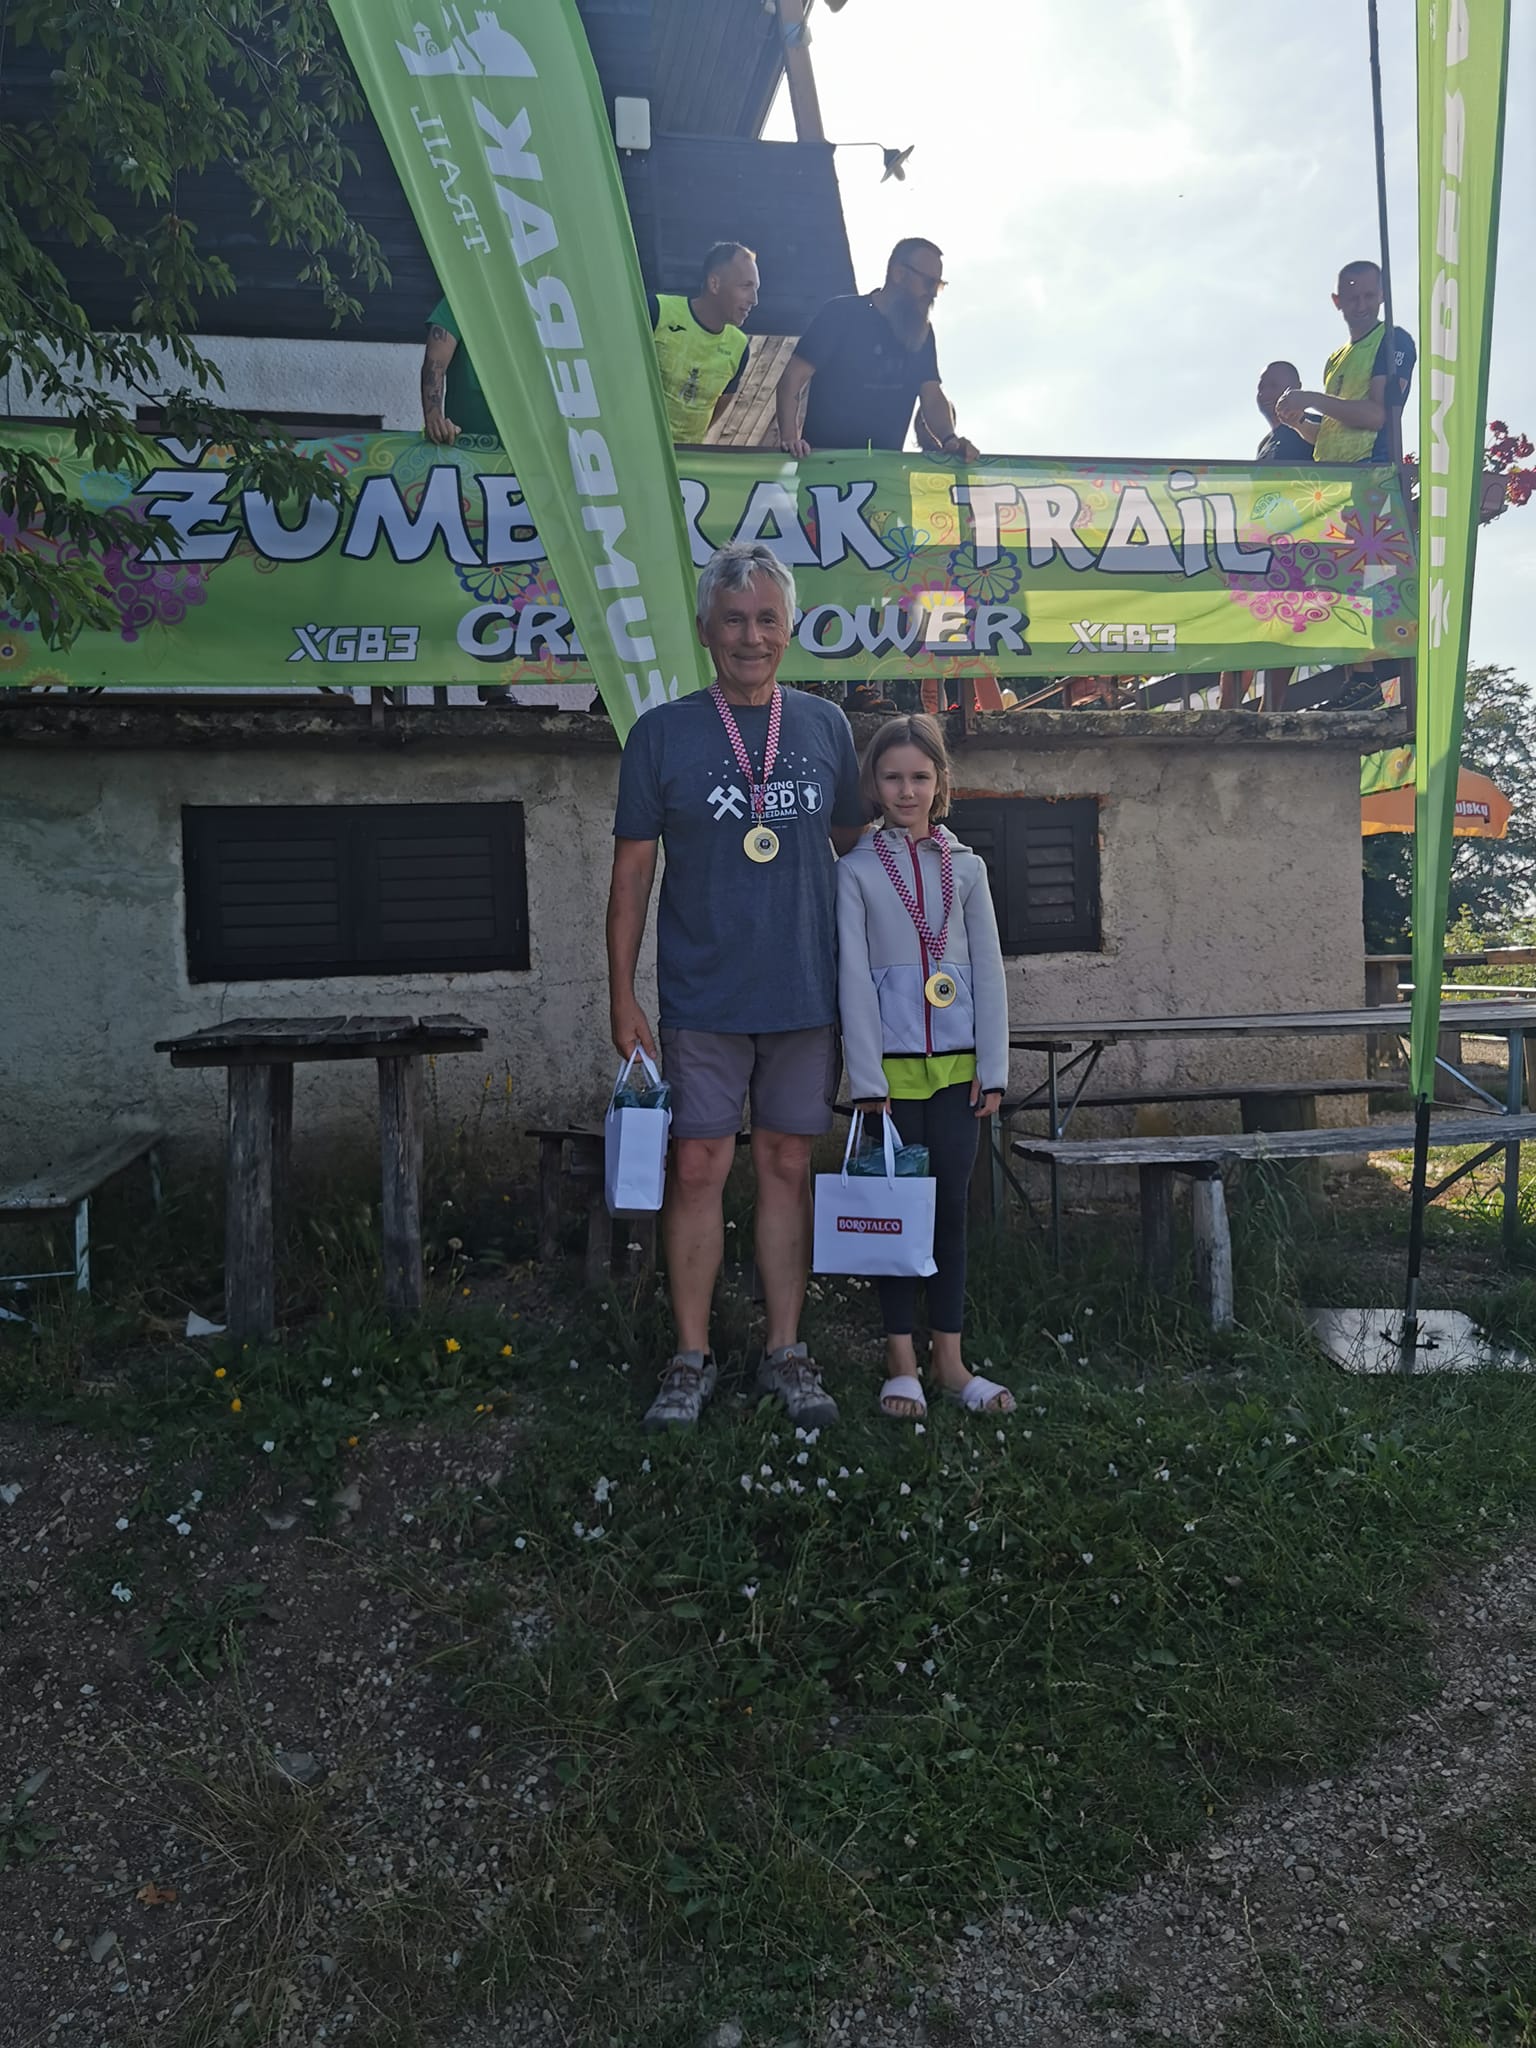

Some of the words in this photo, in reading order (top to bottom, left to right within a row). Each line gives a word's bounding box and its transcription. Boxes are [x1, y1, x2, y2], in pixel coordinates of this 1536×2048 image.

[132, 436, 901, 570] ŽUMBRAK
[286, 622, 420, 662] XGB3
[788, 603, 1030, 658] OWER
[1067, 619, 1176, 654] XGB3
[751, 808, 798, 818] ZJEZDAMA
[839, 1219, 900, 1232] BOROTALCO
